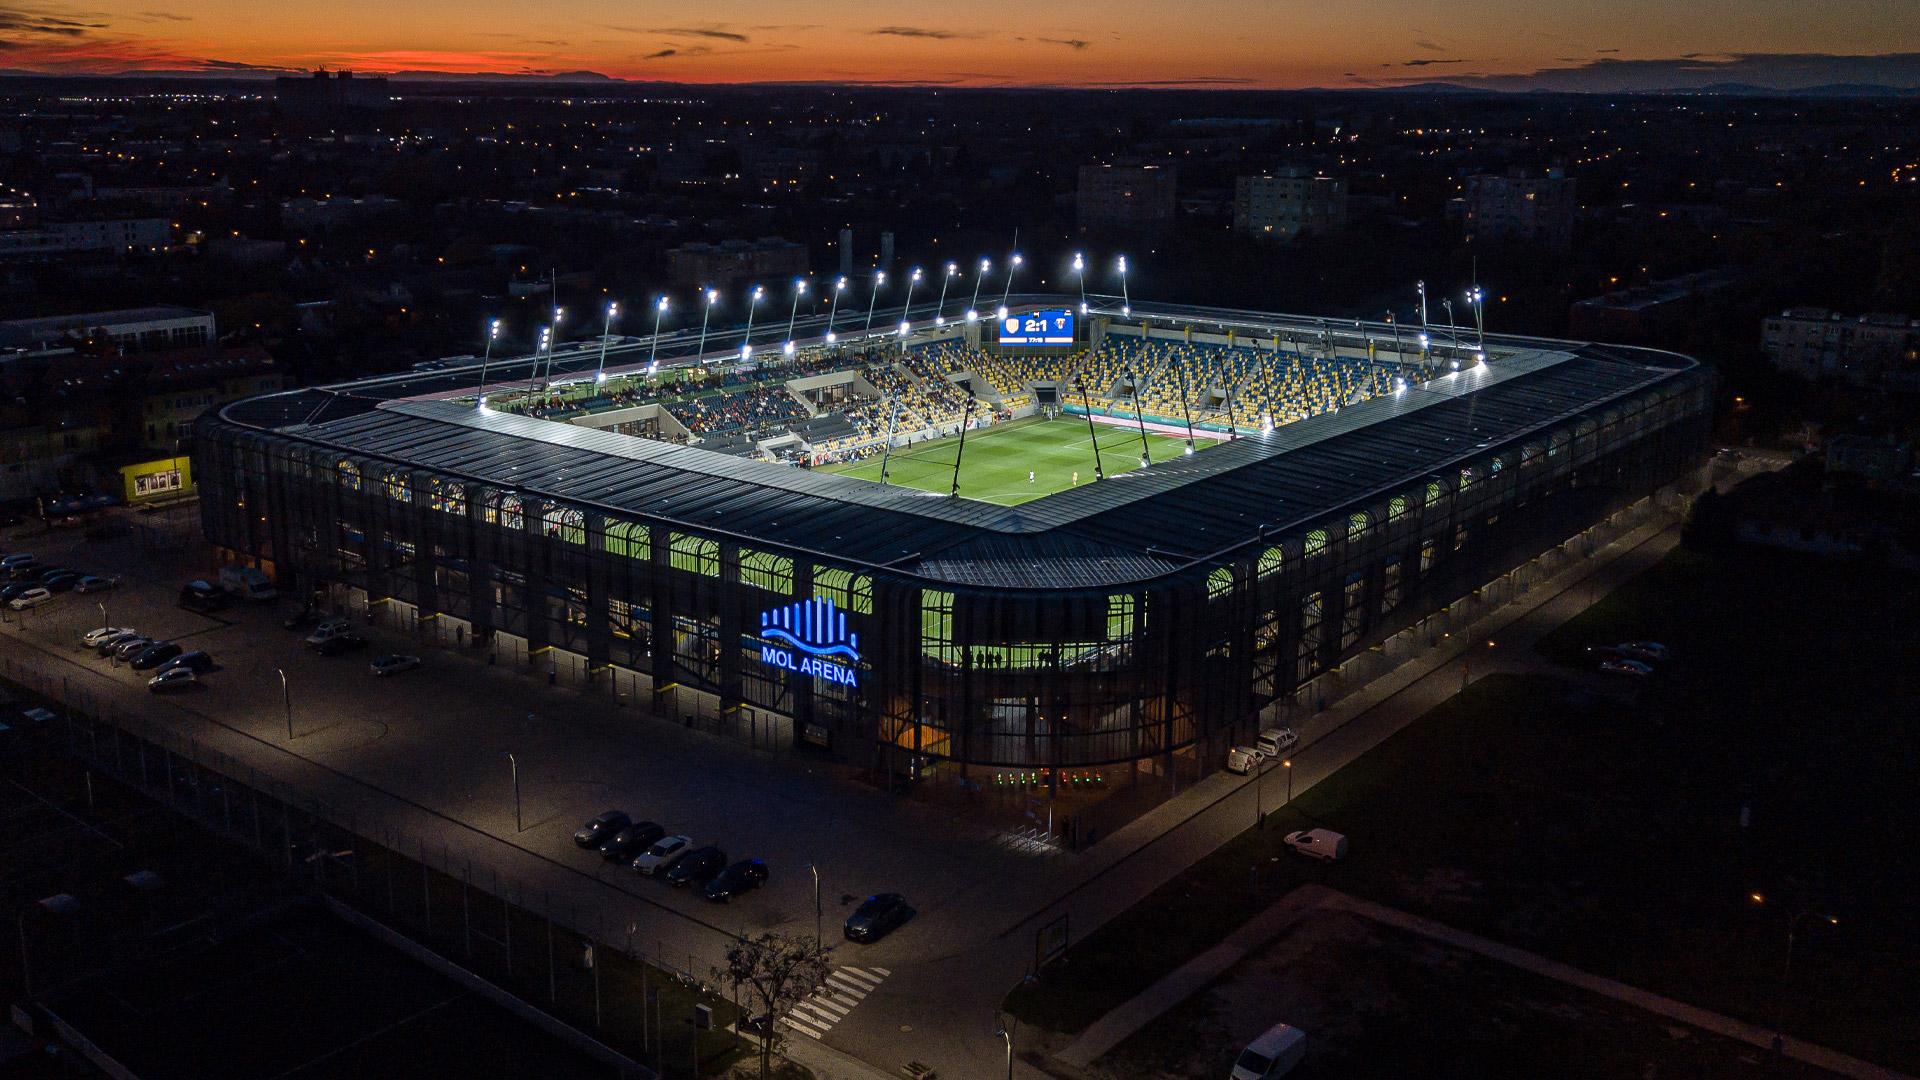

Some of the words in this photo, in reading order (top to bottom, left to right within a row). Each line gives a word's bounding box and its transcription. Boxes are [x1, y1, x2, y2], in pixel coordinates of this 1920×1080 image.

[1025, 319, 1047, 332] 2:1
[762, 646, 797, 670] MOL
[800, 657, 857, 687] ARENA
